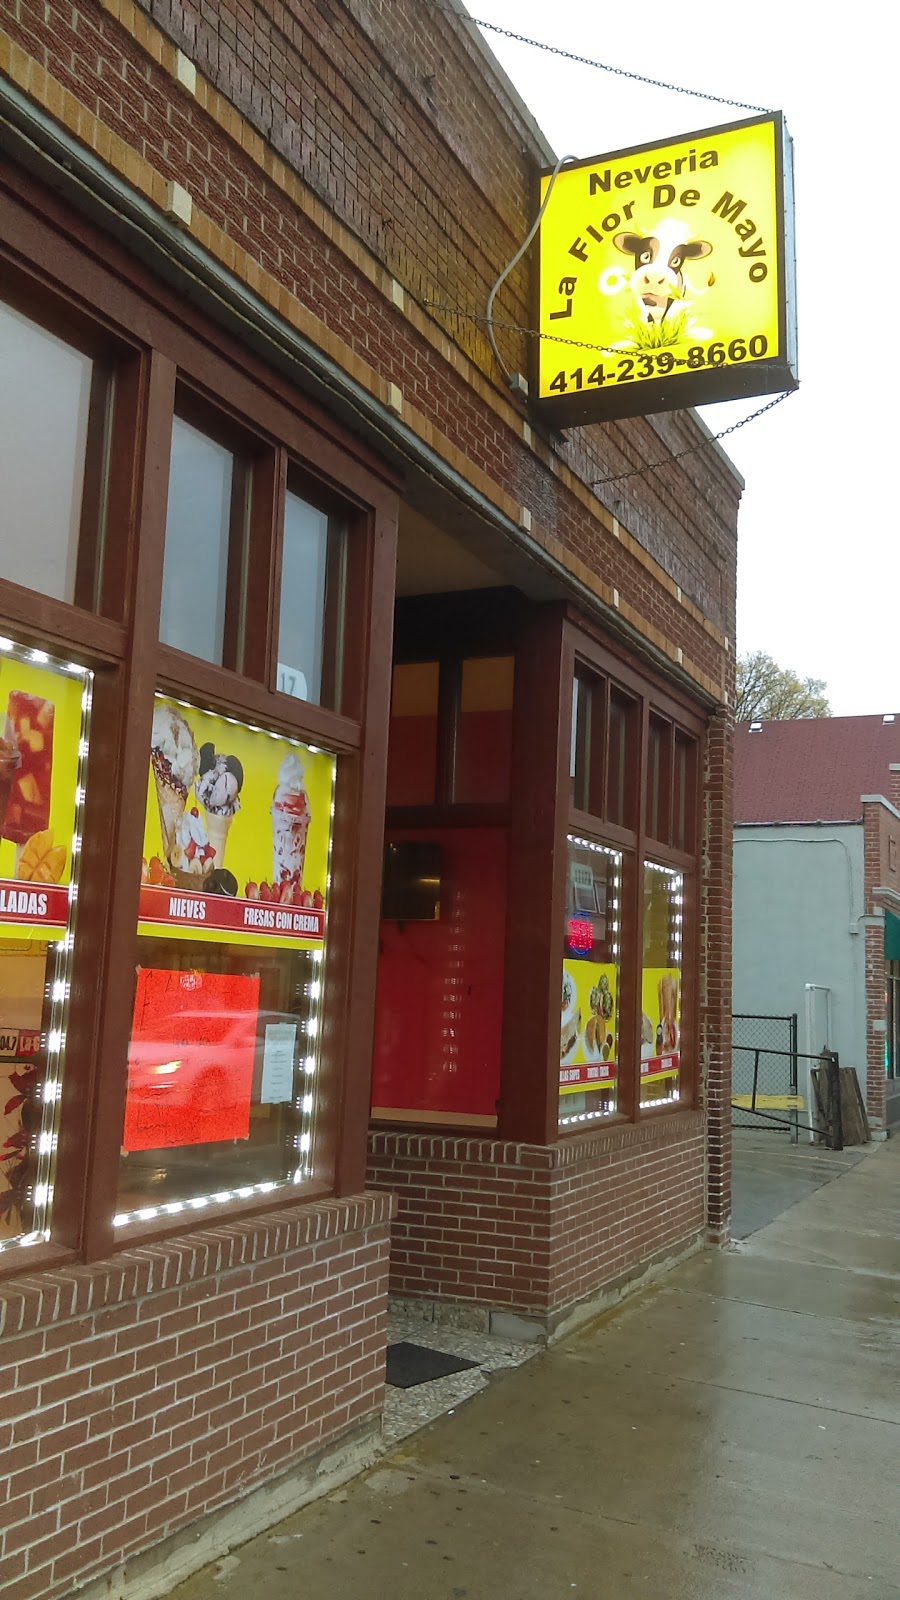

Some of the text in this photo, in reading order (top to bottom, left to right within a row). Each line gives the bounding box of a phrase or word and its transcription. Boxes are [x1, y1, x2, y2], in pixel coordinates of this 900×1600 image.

[589, 149, 719, 196] Neveria
[550, 184, 768, 320] La Flor De Mayo
[549, 334, 768, 393] 414-239-8660
[0, 889, 47, 915] LADAS
[169, 897, 206, 919] NIEVES
[244, 907, 319, 932] FRESAS CON CREMA
